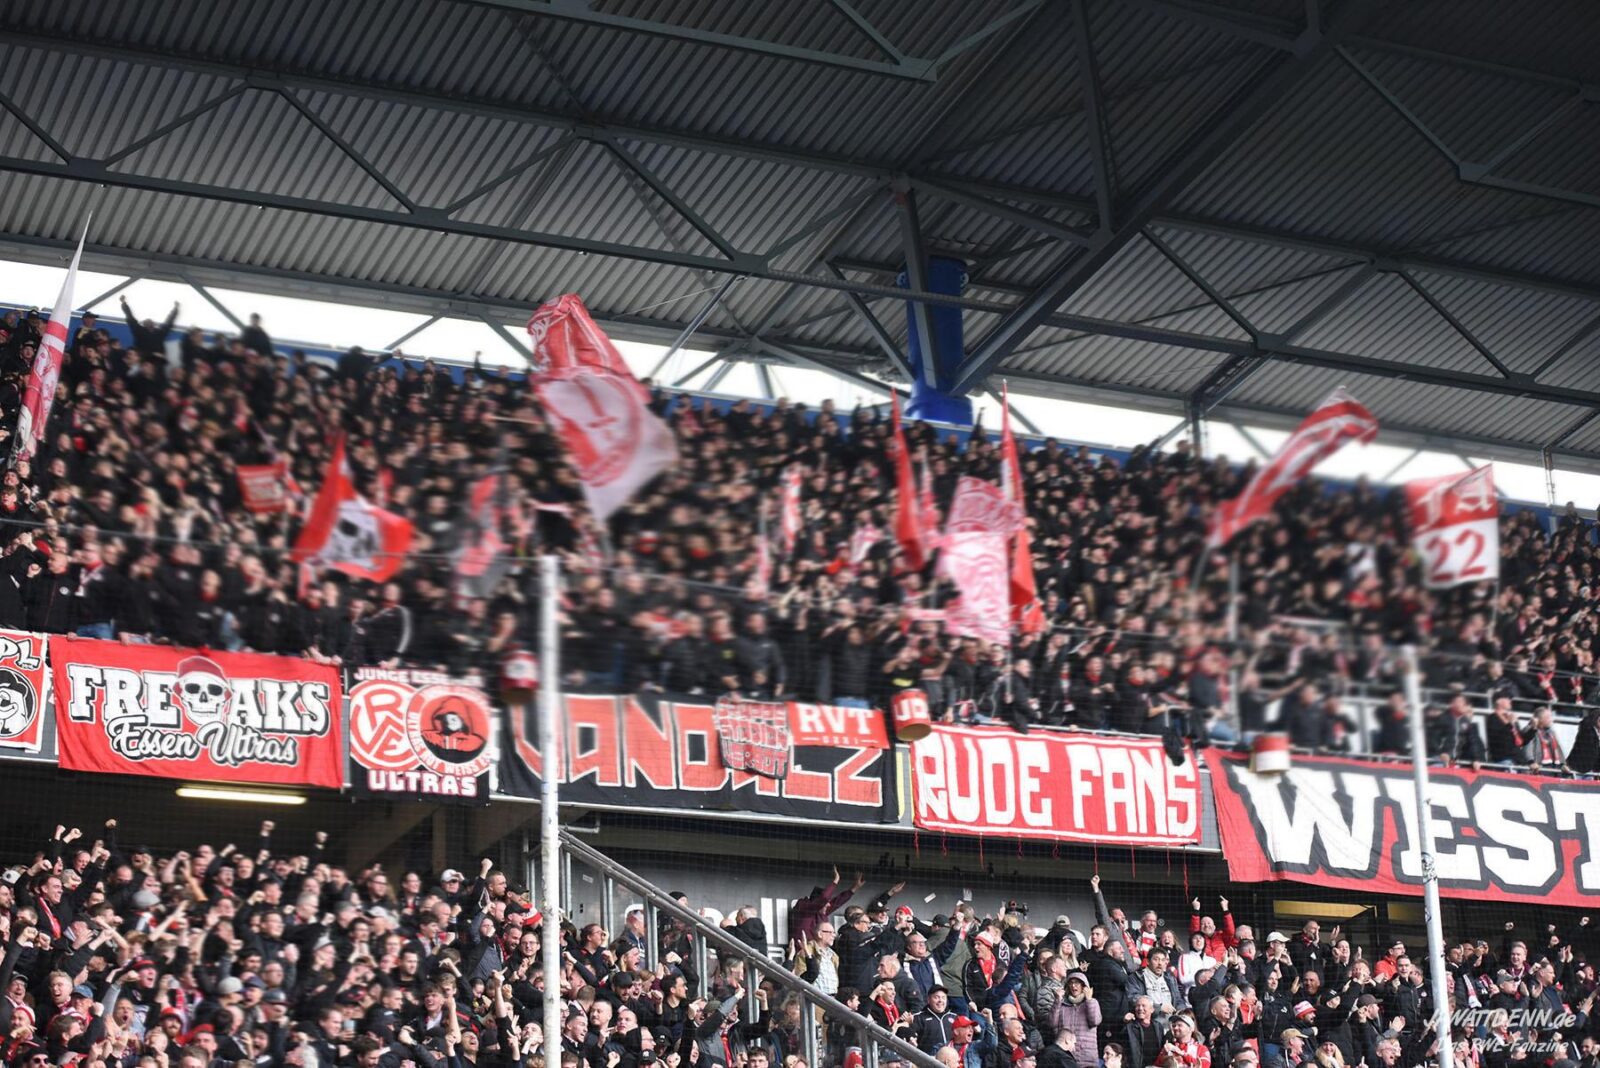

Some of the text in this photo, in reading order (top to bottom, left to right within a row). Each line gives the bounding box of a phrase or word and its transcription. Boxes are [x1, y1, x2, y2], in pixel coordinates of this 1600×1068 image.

[1426, 528, 1486, 584] 22
[354, 667, 409, 683] JUNGE
[68, 663, 330, 736] FREAKS
[795, 703, 873, 735] RVT
[108, 716, 297, 764] Essen Ultras
[369, 770, 477, 796] ULTRAS
[916, 733, 1197, 836] RUDE FANS
